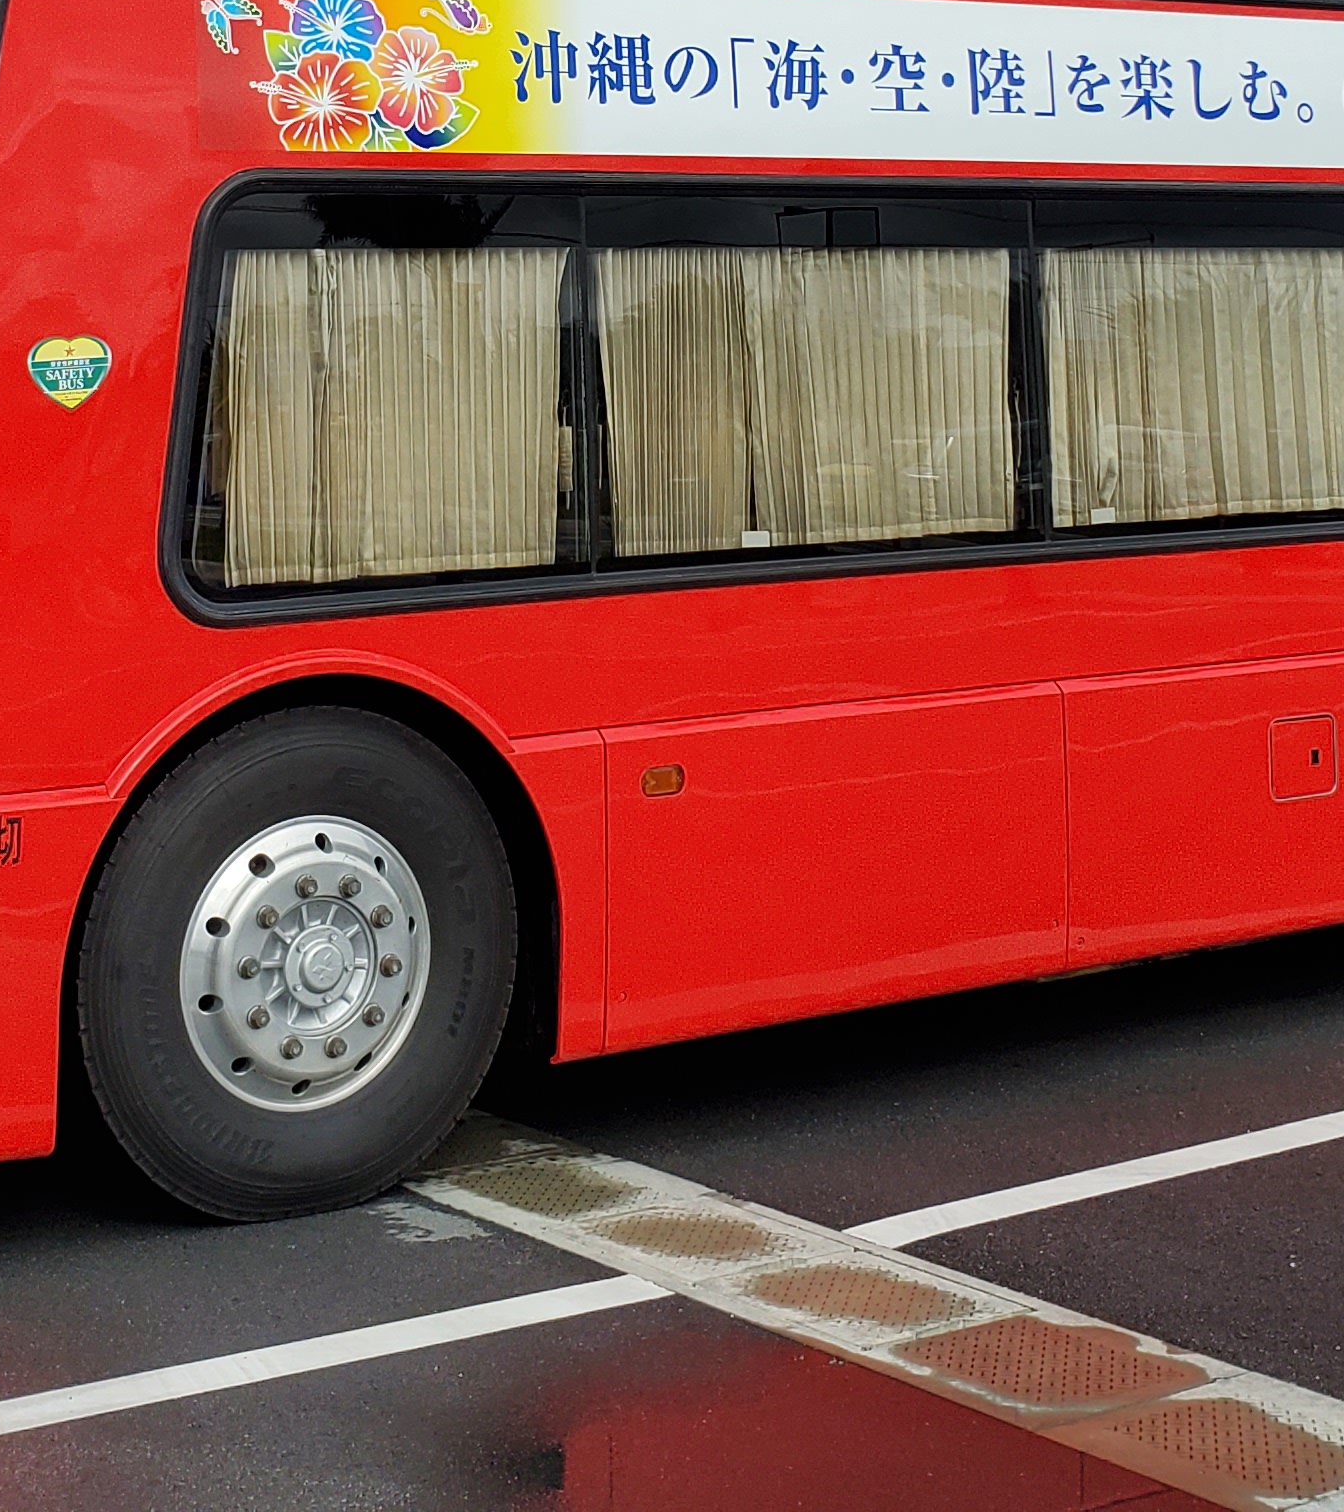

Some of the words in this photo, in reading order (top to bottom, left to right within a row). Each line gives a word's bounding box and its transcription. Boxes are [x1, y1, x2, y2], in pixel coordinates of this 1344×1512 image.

[509, 29, 1315, 124] 沖縄の「海・空・陸」を楽しむ。
[45, 367, 95, 381] SAFETY
[58, 378, 85, 390] BUS
